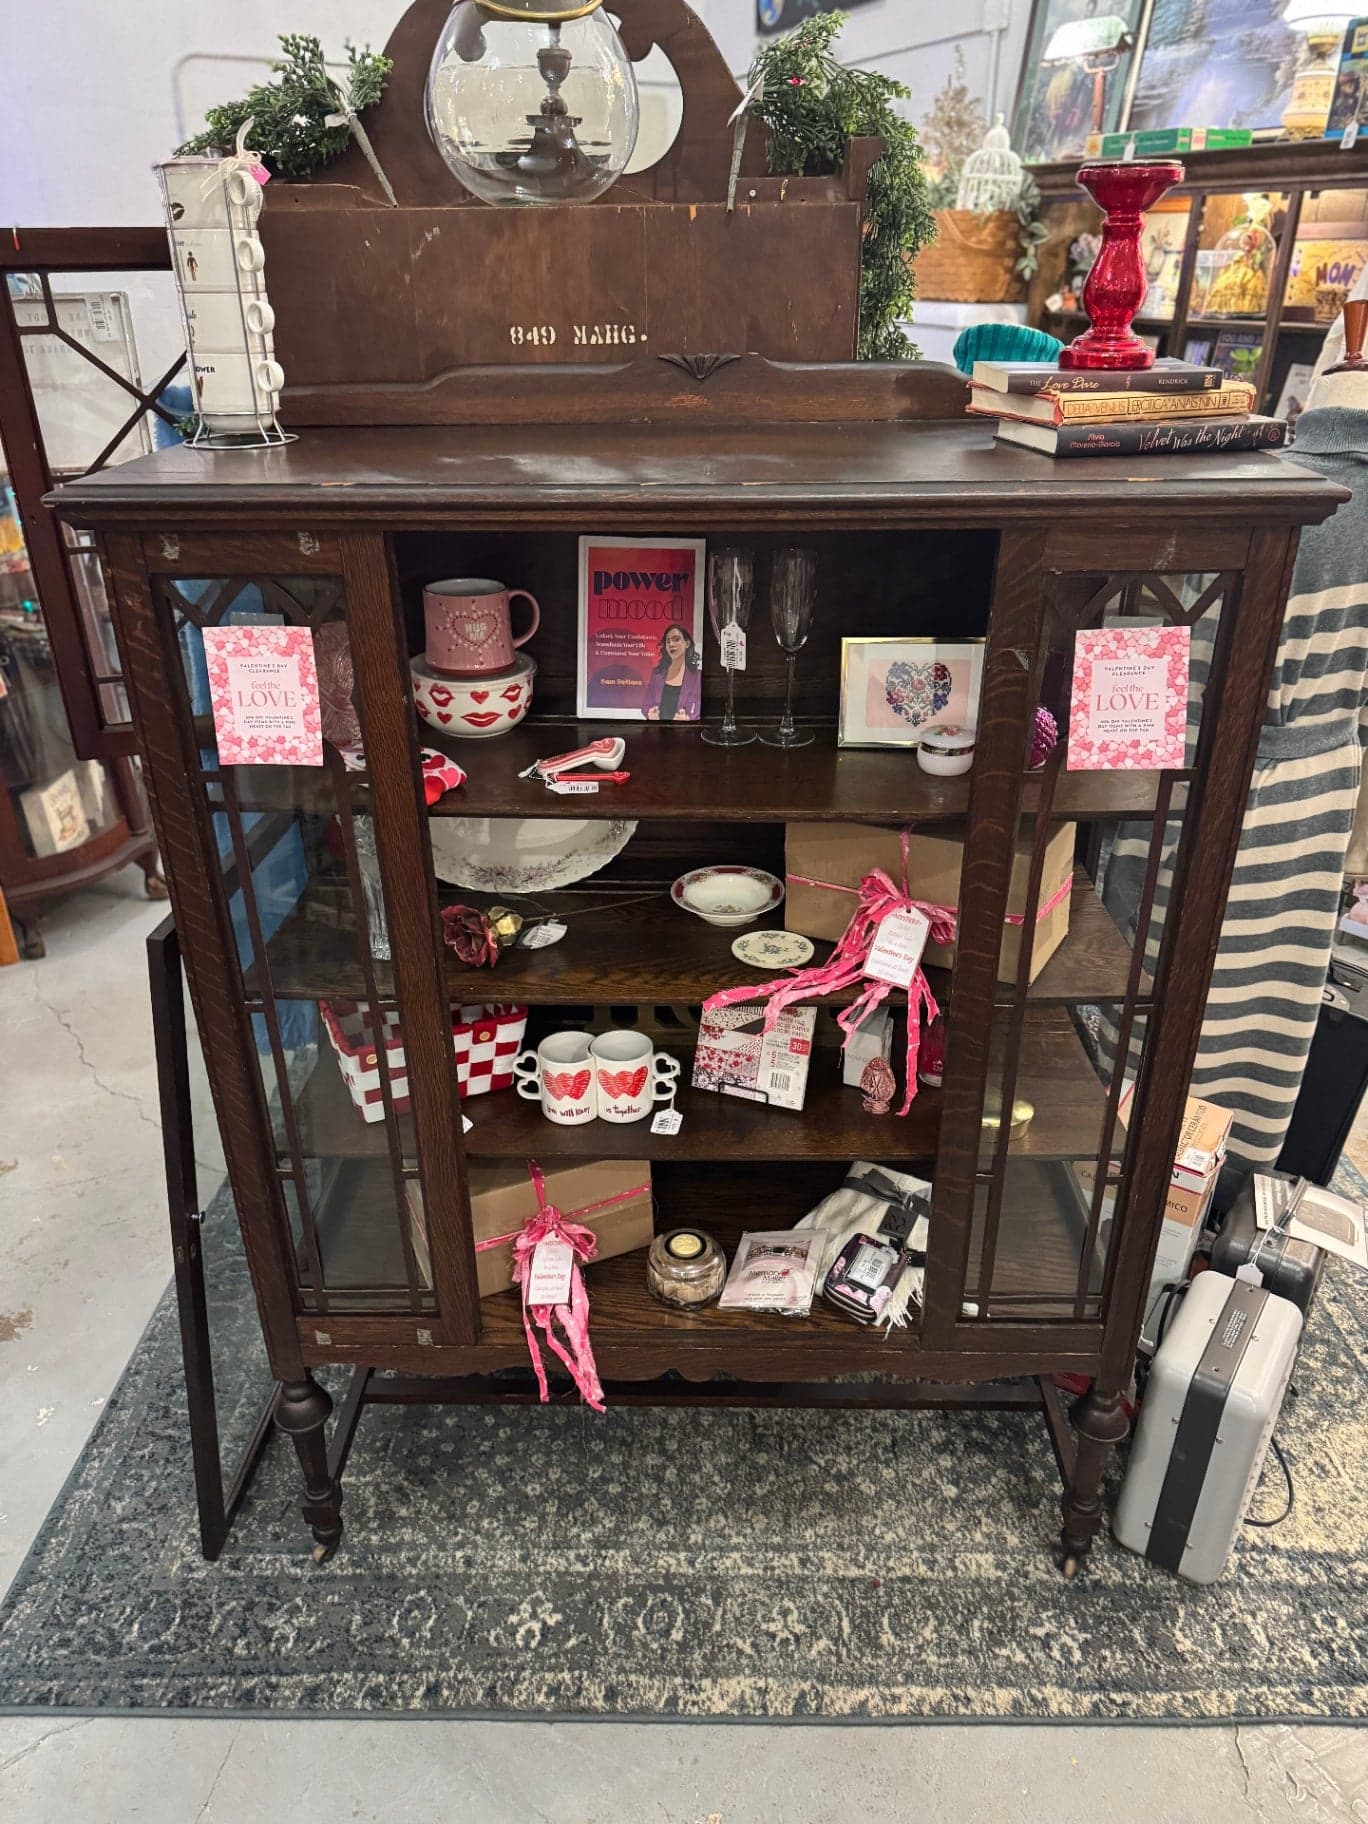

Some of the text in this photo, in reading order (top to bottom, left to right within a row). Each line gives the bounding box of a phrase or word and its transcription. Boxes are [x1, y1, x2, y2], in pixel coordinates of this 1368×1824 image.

[510, 326, 556, 345] 849
[195, 365, 216, 373] OWER
[1040, 376, 1070, 391] Love
[1072, 376, 1100, 390] Dare
[1131, 398, 1168, 413] EROTICA
[1139, 428, 1174, 450] Velvet
[1172, 433, 1192, 450] Was
[1195, 425, 1212, 445] the
[1208, 425, 1244, 448] Night
[593, 571, 689, 595] power
[599, 596, 683, 621] mood
[465, 622, 487, 633] HUG
[238, 690, 297, 707] LOVE
[1096, 692, 1159, 712] LOVE
[791, 1041, 802, 1051] 30
[612, 1105, 641, 1117] together
[1166, 1200, 1188, 1213] MICO
